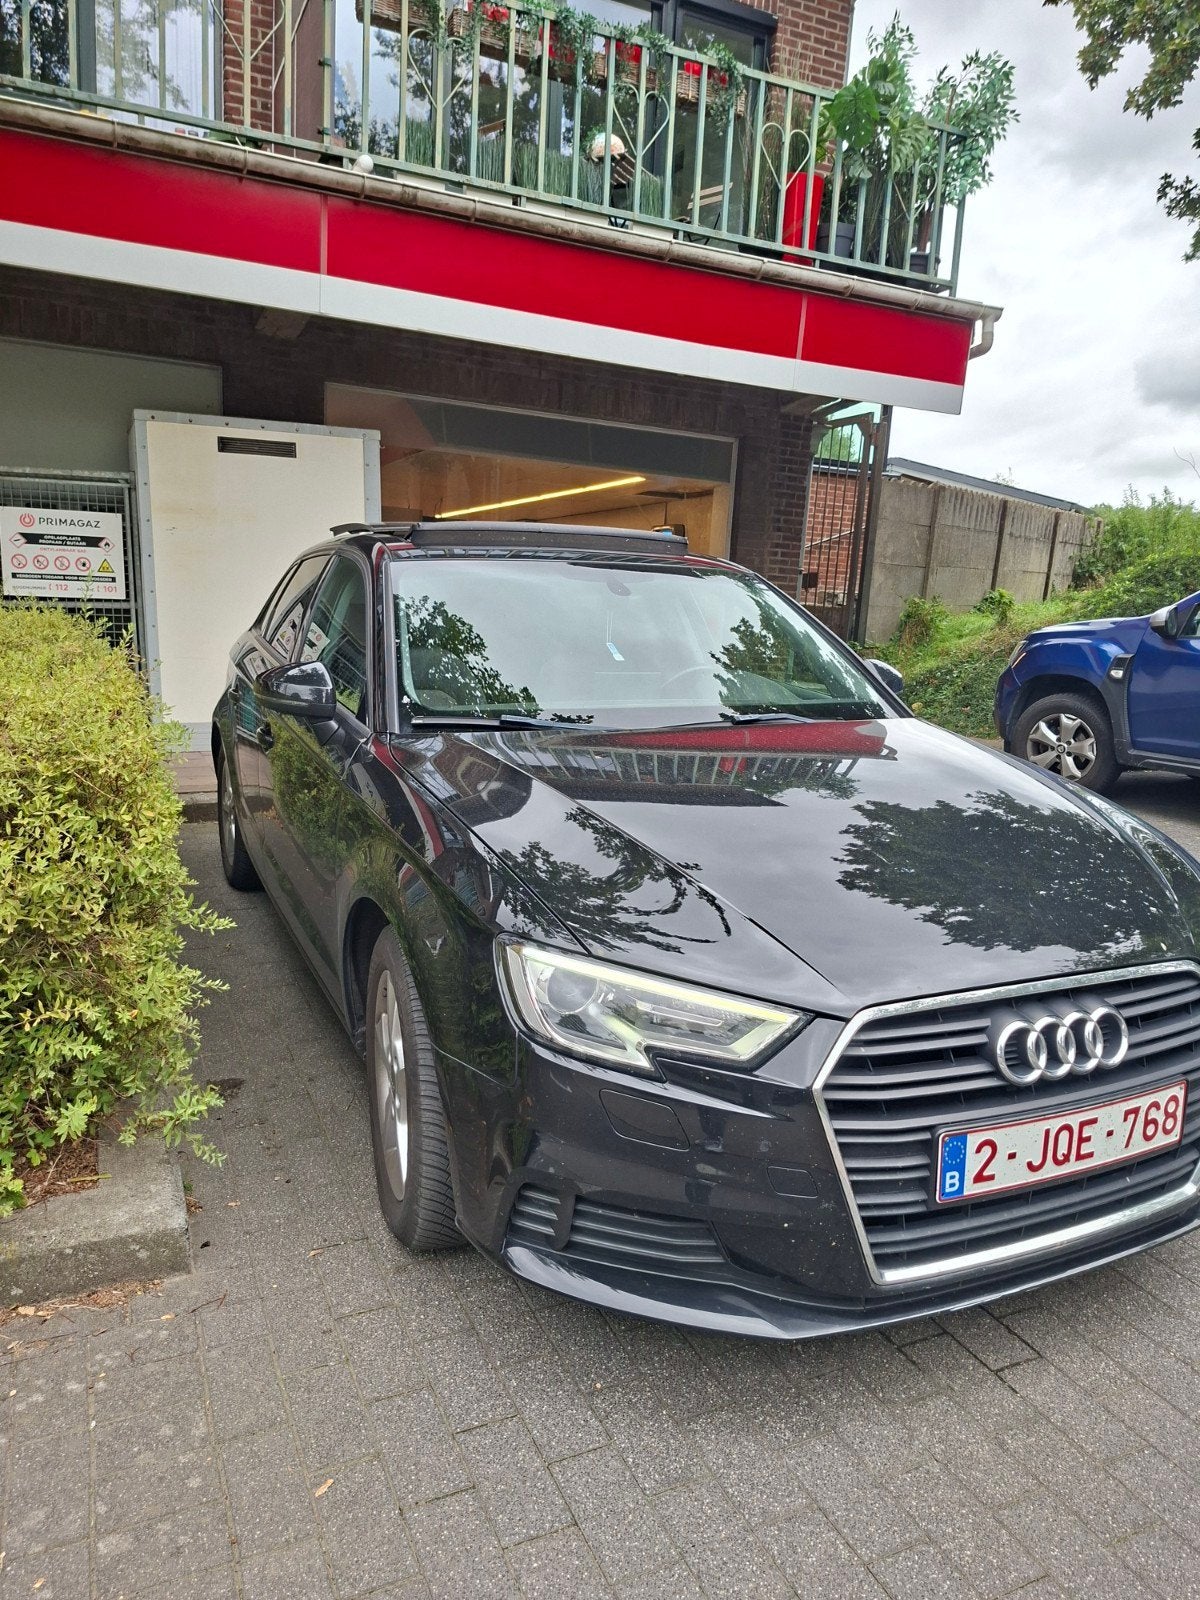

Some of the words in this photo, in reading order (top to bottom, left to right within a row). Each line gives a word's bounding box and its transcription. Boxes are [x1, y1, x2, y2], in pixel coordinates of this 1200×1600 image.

[38, 517, 101, 529] PRIMAGAZ
[945, 1171, 960, 1192] B
[973, 1094, 1180, 1184] 2-JQE-768
